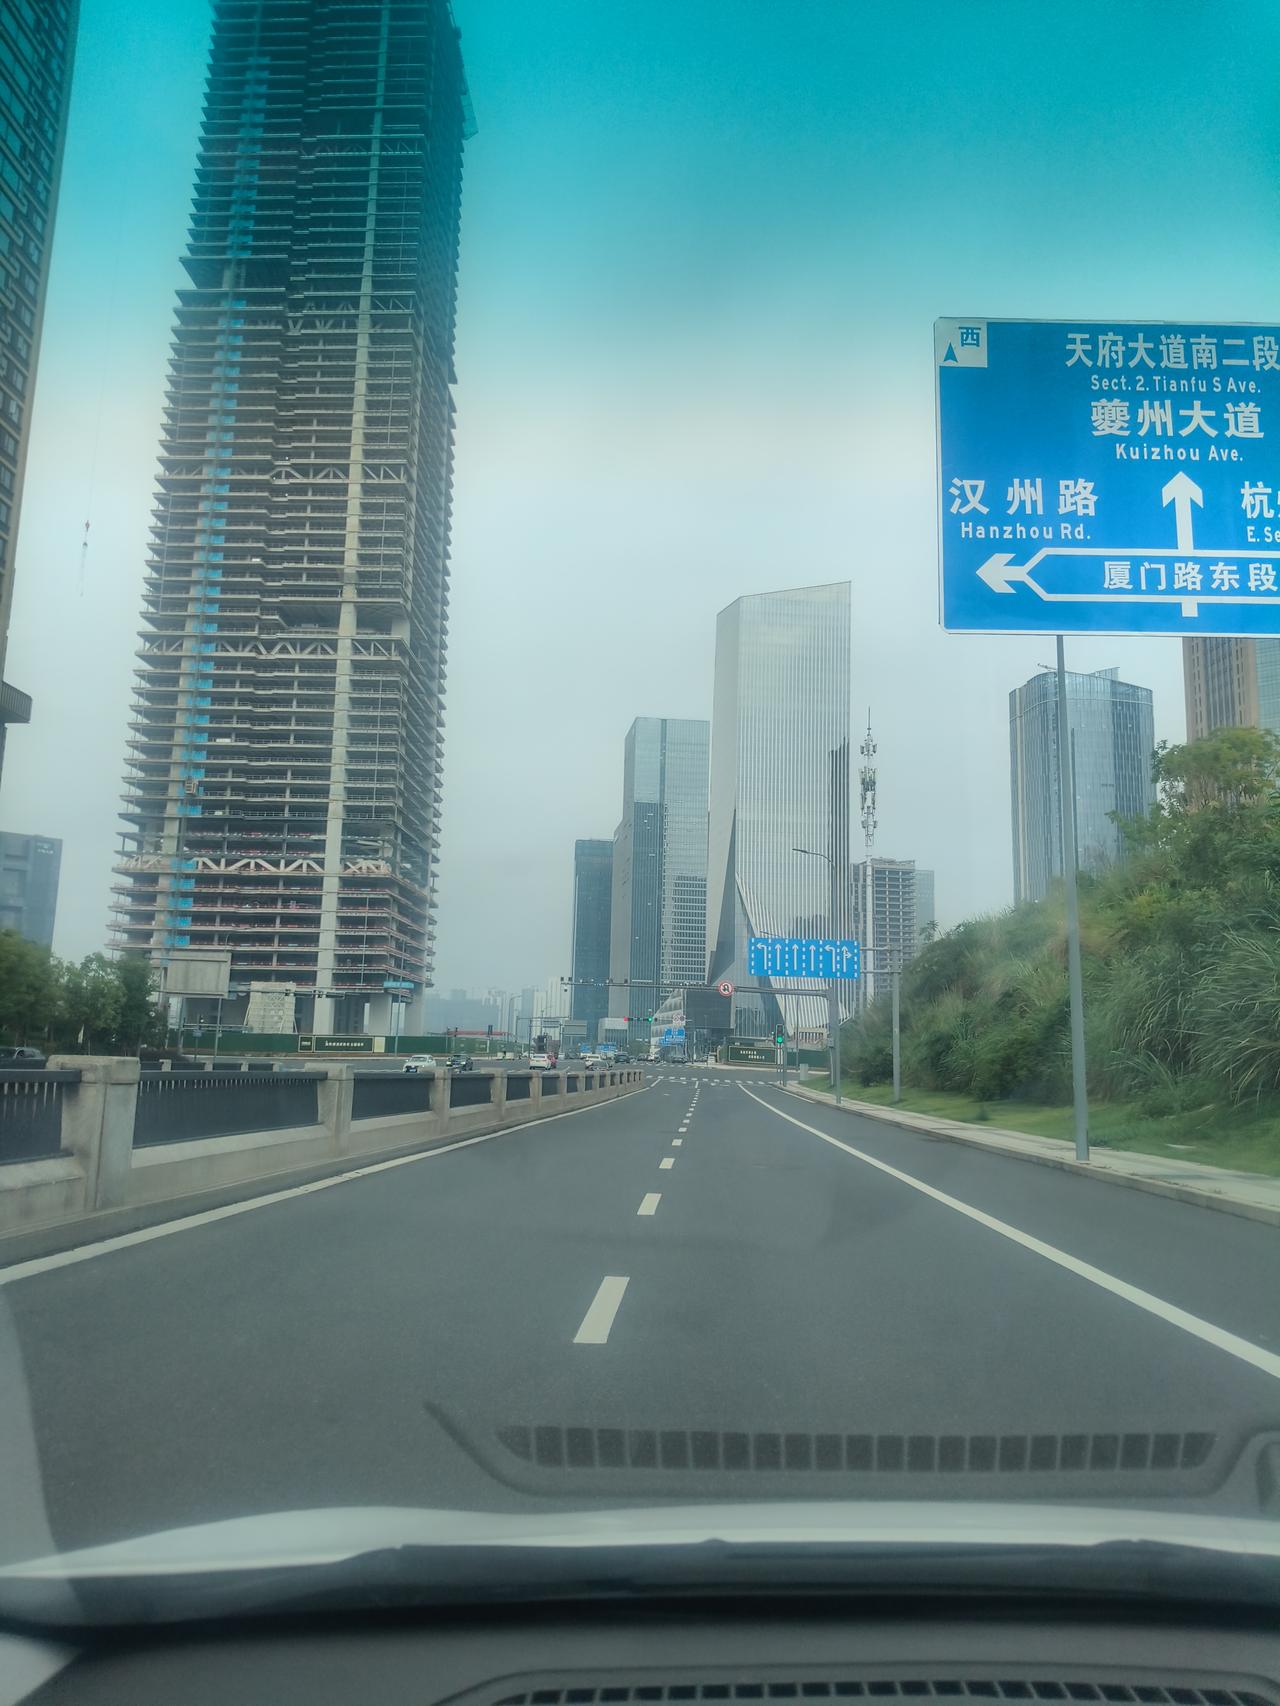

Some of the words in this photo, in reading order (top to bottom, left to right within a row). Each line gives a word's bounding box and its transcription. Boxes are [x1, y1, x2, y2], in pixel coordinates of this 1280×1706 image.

[958, 326, 982, 347] 西
[1065, 331, 1280, 371] 天府大道南二段
[1091, 374, 1132, 391] Sect.
[1153, 375, 1207, 392] Tianfu
[1212, 376, 1222, 393] S
[1227, 376, 1261, 394] Ave.
[1091, 398, 1265, 439] 夔州大道
[1115, 443, 1200, 461] Kuizhou
[1208, 444, 1244, 462] Ave.
[949, 477, 1099, 516] 汉州路
[1240, 480, 1280, 519] 杭
[961, 522, 1053, 539] Hanzhou
[1060, 522, 1091, 540] Rd.
[1246, 525, 1260, 542] E.
[1103, 560, 1278, 592] 厦门路东段
